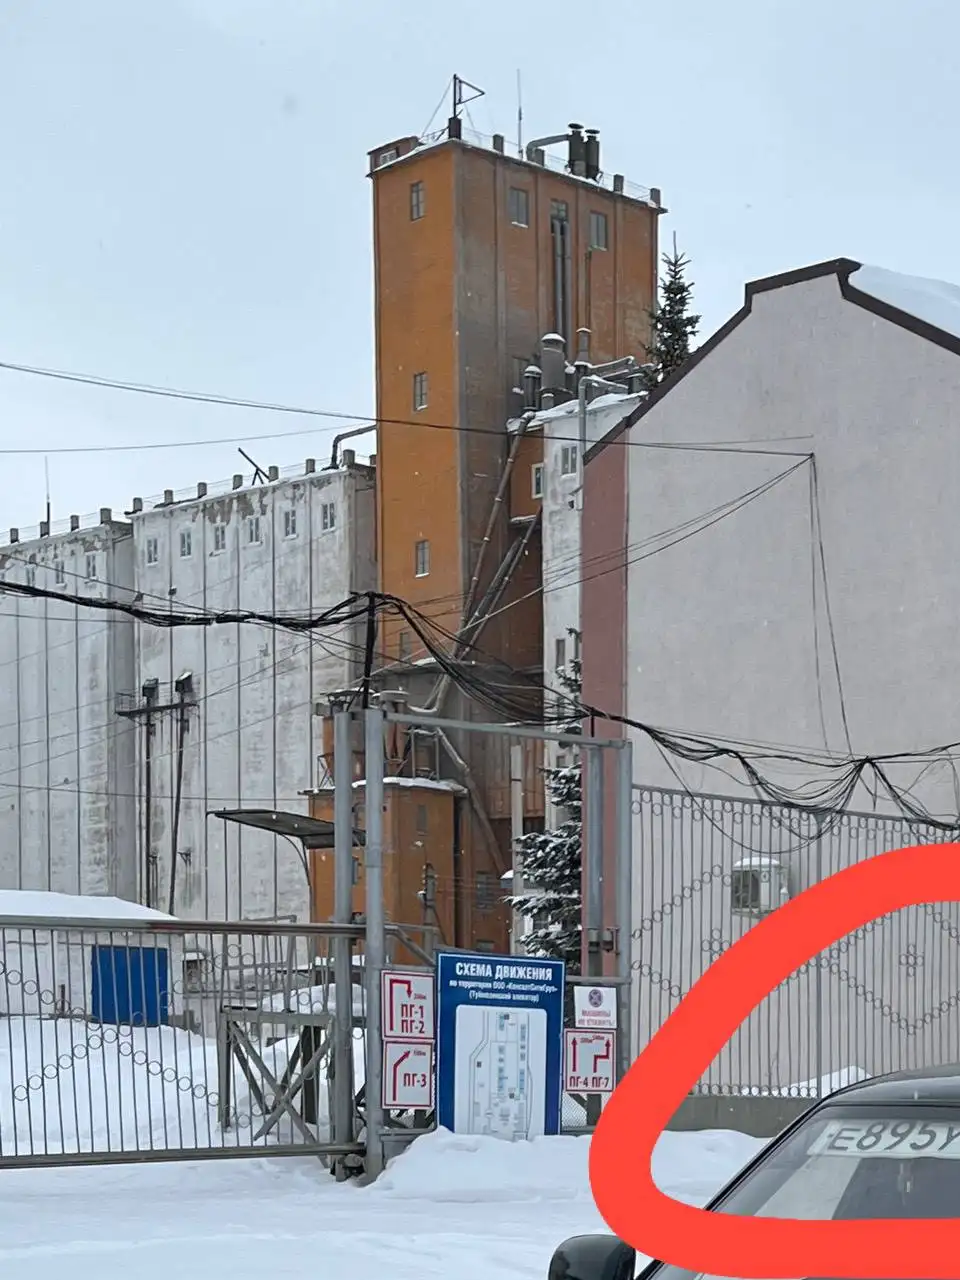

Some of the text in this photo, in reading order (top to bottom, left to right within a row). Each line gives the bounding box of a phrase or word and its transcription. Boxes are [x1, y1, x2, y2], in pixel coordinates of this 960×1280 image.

[455, 963, 553, 981] СХЕМА ДВИЖЕНИЯ
[400, 1004, 424, 1018] ПГ-1
[401, 1019, 425, 1034] ПГ-2
[403, 1073, 427, 1087] ПГ-3
[569, 1076, 609, 1088] ПГ-4 ПГ-7
